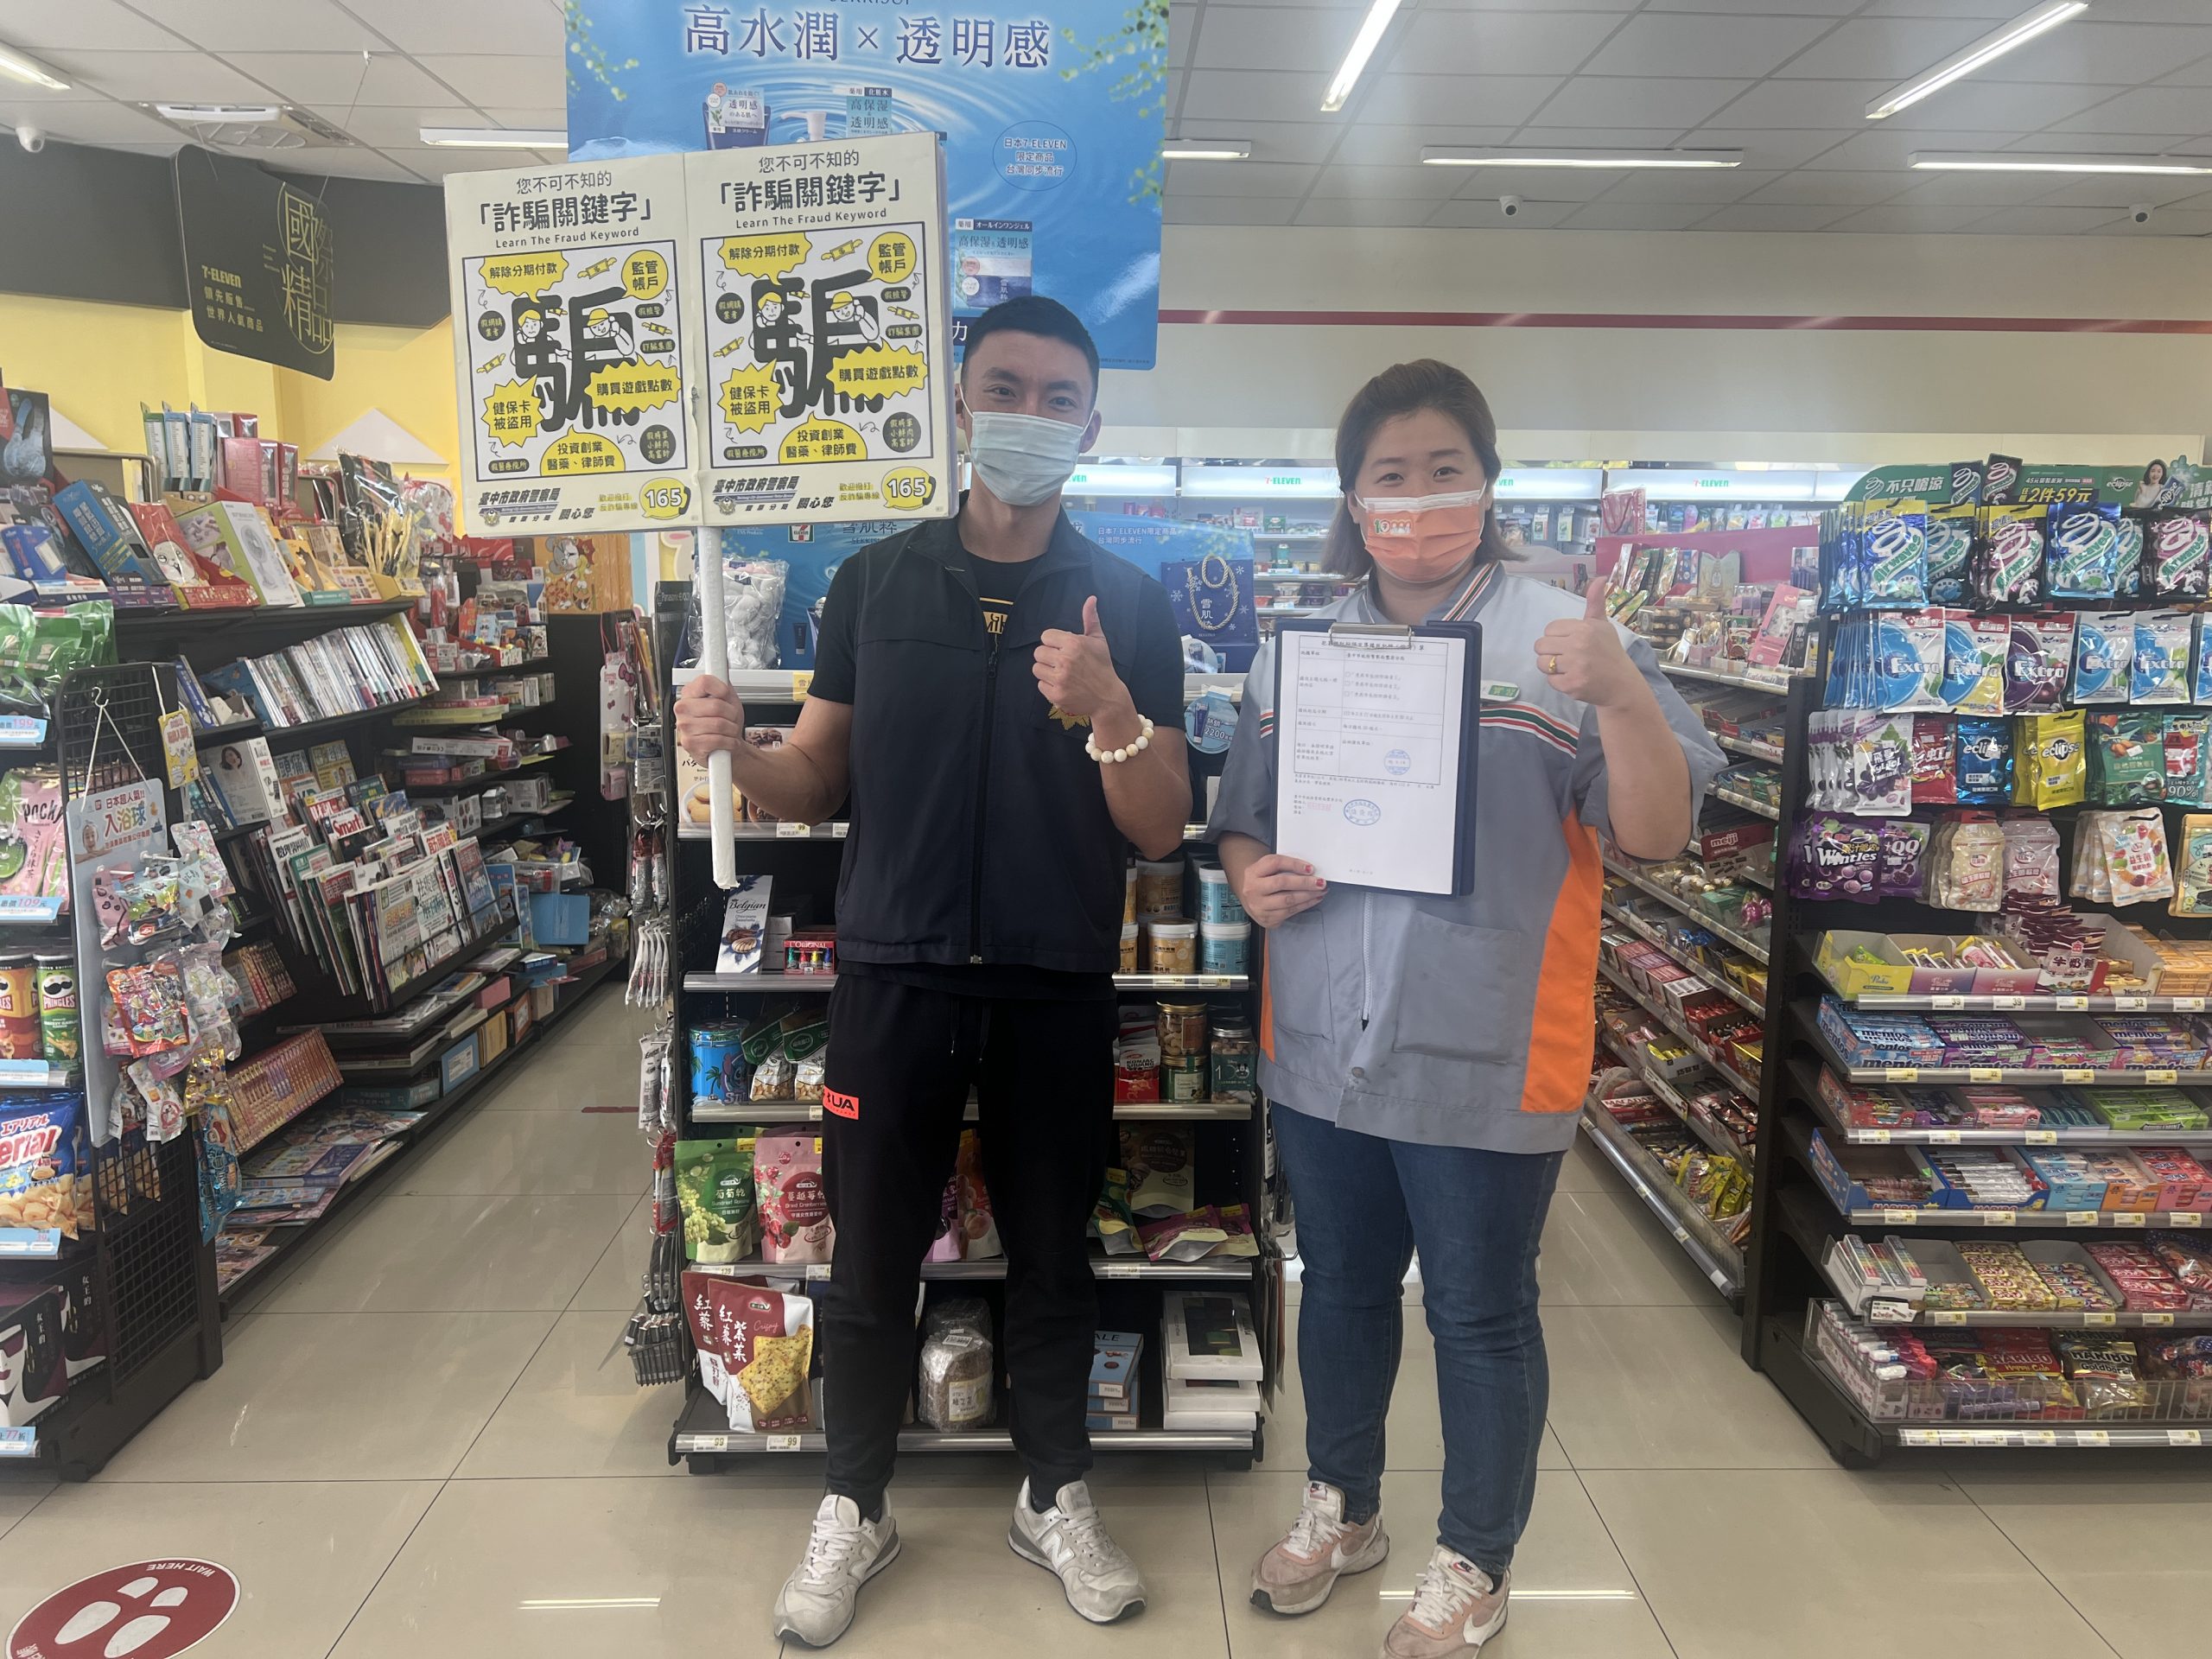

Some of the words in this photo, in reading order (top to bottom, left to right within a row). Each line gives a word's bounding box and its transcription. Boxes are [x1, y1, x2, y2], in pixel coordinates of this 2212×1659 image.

[728, 99, 758, 110] 透明感
[850, 99, 888, 111] 高保湿
[850, 117, 888, 129] 透明感
[1005, 138, 1066, 149] 日本7-ELEVEN
[759, 149, 859, 173] 您不可不知的
[1016, 151, 1053, 162] 限定商品
[1007, 164, 1064, 175] 台灣同步流行
[517, 170, 612, 194] 您不可不知的
[721, 171, 899, 213] 「詐騙關鍵字」
[480, 191, 651, 232] 「詐騙關鍵字」
[736, 218, 768, 229] Learn
[772, 216, 792, 226] The
[798, 213, 831, 224] Fraud
[836, 208, 887, 221] Keyword
[976, 221, 1030, 230] オールインワンジェル
[496, 237, 526, 248] Learn
[531, 236, 550, 245] The
[555, 232, 586, 243] Fraud
[591, 227, 639, 240] Keyword
[997, 236, 1029, 249] 透明感
[729, 244, 800, 260] 解除分期付款
[878, 242, 906, 257] 監管
[490, 261, 557, 279] 解除分期付款
[632, 260, 658, 276] 監管
[879, 258, 906, 274] 帳戶
[201, 264, 242, 288] 7-ELEVEN
[632, 276, 658, 291] 帳戶
[953, 321, 967, 340] 力
[839, 365, 918, 382] 購買遊戲點數
[596, 380, 672, 396] 購買遊戲點數
[730, 385, 769, 400] 健保卡
[493, 401, 531, 415] 健保卡
[730, 401, 770, 416] 被盜用
[494, 416, 531, 430] 被盜用
[798, 429, 843, 442] 投資創業
[557, 441, 603, 454] 投資創業
[786, 442, 856, 458] 醫藥、律師費
[547, 454, 614, 471] 醫藥、律師費
[714, 476, 799, 493] 臺中市政府警察局
[887, 478, 926, 498] 165
[1265, 476, 1300, 485] 7-ELEVEN
[1886, 477, 1944, 494] 不只嗆涼
[479, 487, 561, 505] 臺中市政府警察局
[645, 488, 683, 508] 165
[797, 496, 835, 509] 關心您
[2028, 487, 2092, 503] 2件59元
[2158, 481, 2178, 510] eclipse
[558, 507, 594, 520] 關心您
[1873, 535, 1923, 582] Airwaves
[2059, 528, 2114, 578] Airwaves
[2161, 534, 2204, 576] Airwaves
[1891, 657, 1941, 674] Extra
[1948, 658, 2001, 678] Extra
[2014, 660, 2064, 679] Extra
[2139, 656, 2185, 670] Extra
[2042, 741, 2081, 759] eclipse
[2169, 785, 2197, 798] 90%
[105, 807, 146, 837] 入浴球
[1711, 832, 1738, 849] meiji
[729, 899, 767, 913] Belgian
[43, 995, 75, 1009] PRINGLES
[1820, 1018, 1850, 1060] mentos
[1861, 1029, 1910, 1038] mentos
[1862, 1058, 1936, 1068] mentos
[1, 1115, 49, 1135] エアリアル
[715, 1188, 746, 1199] 葡萄乾
[694, 1294, 713, 1332] 紅藜
[719, 1304, 734, 1346] 紅藜
[753, 1319, 779, 1333] Crispy
[733, 1320, 747, 1363] 紫菜
[1094, 1332, 1120, 1342] ALE
[1993, 1354, 2053, 1365] HARIBO
[2072, 1351, 2134, 1365] HARIBO
[714, 1437, 724, 1446] 99
[787, 1436, 798, 1446] 99
[146, 1562, 185, 1572] HERE
[185, 1563, 215, 1578] WAIT
